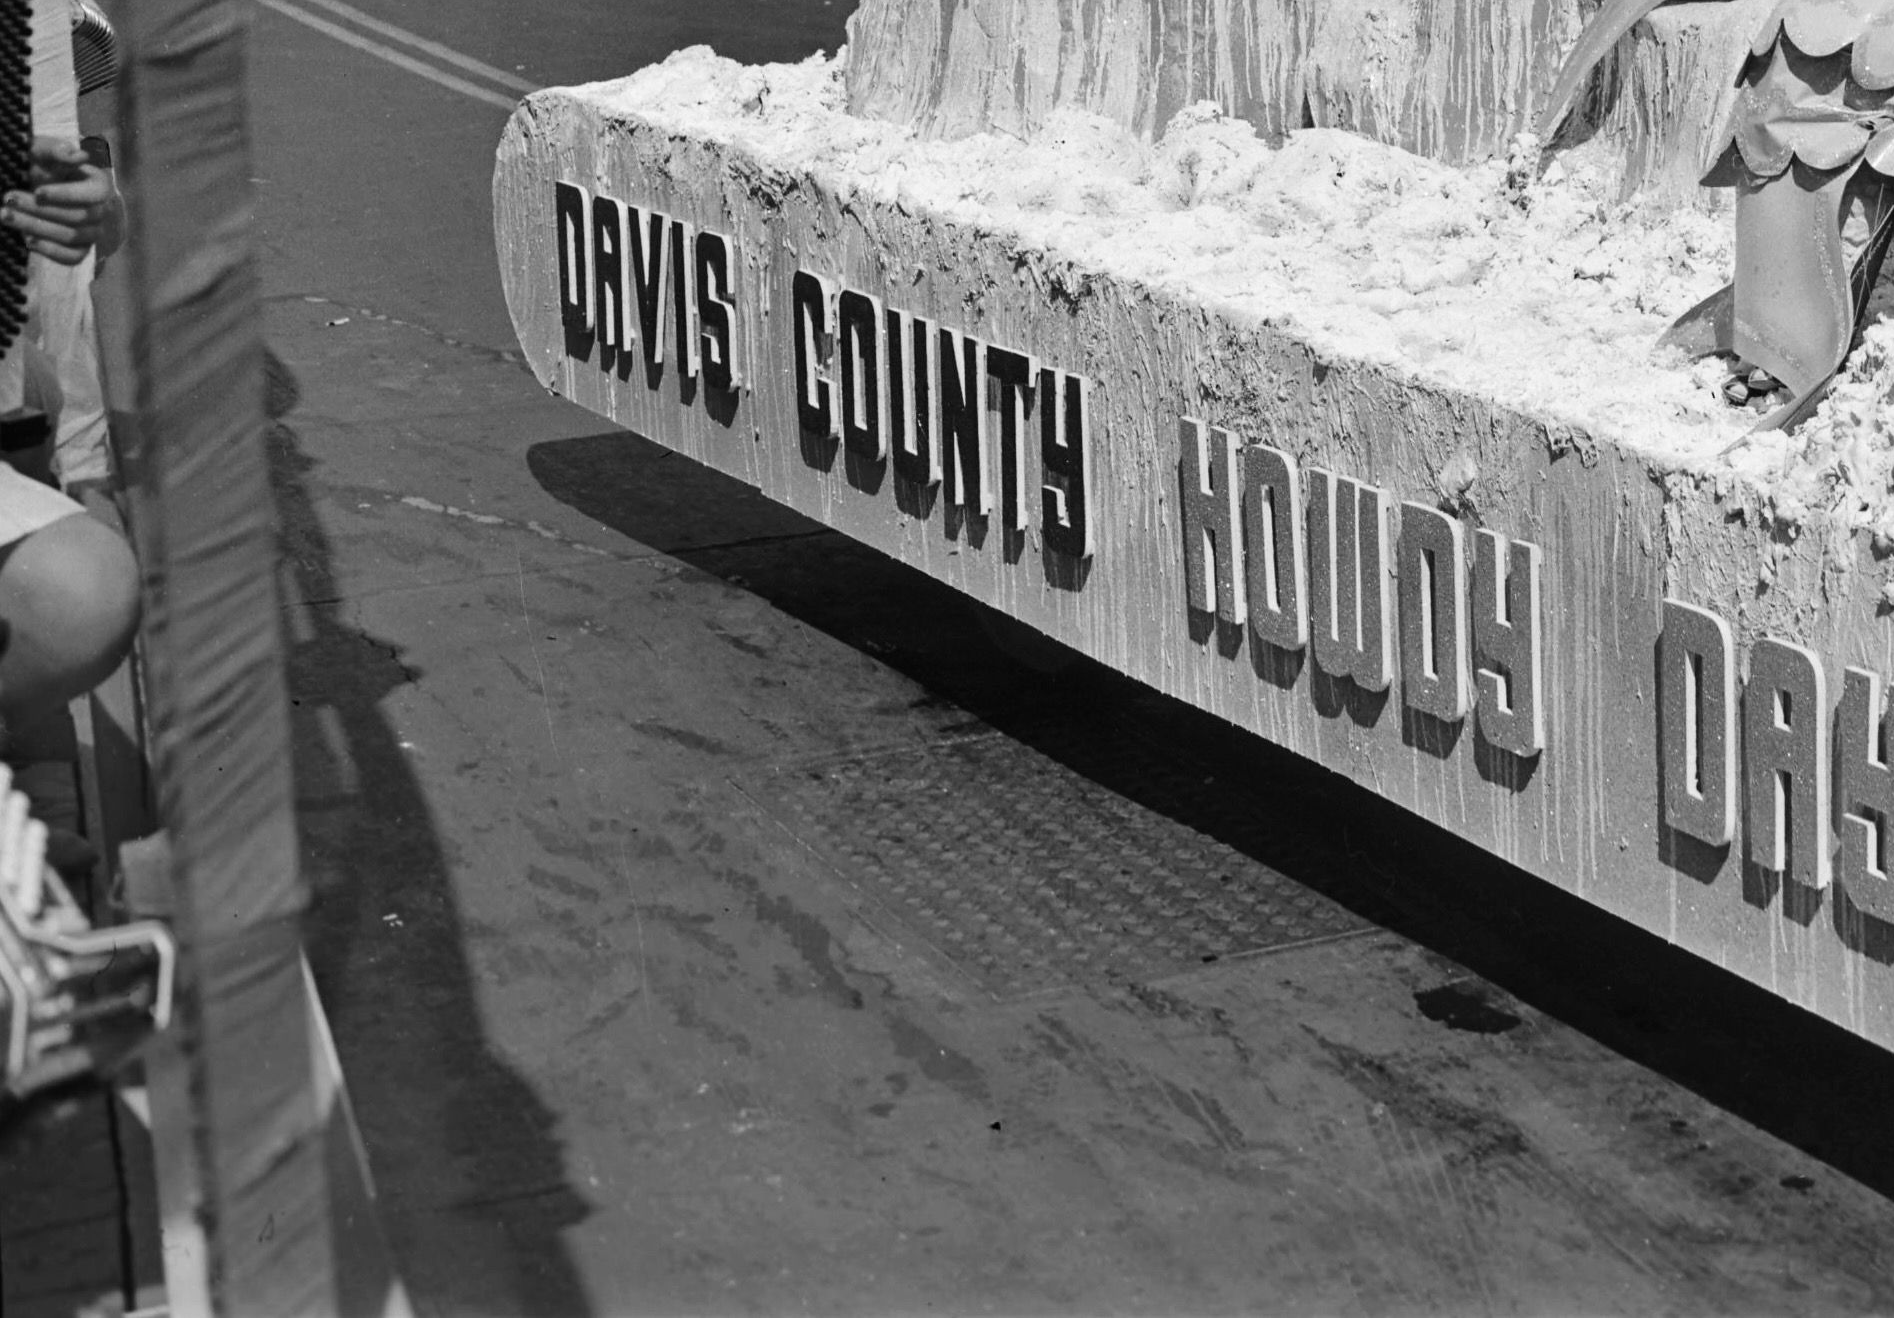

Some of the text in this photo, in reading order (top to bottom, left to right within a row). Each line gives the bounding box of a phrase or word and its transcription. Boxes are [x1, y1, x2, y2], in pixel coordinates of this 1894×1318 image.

[555, 179, 741, 393] DAVIS
[793, 268, 1092, 558] COUNTY
[1180, 414, 1544, 758] HOWDY
